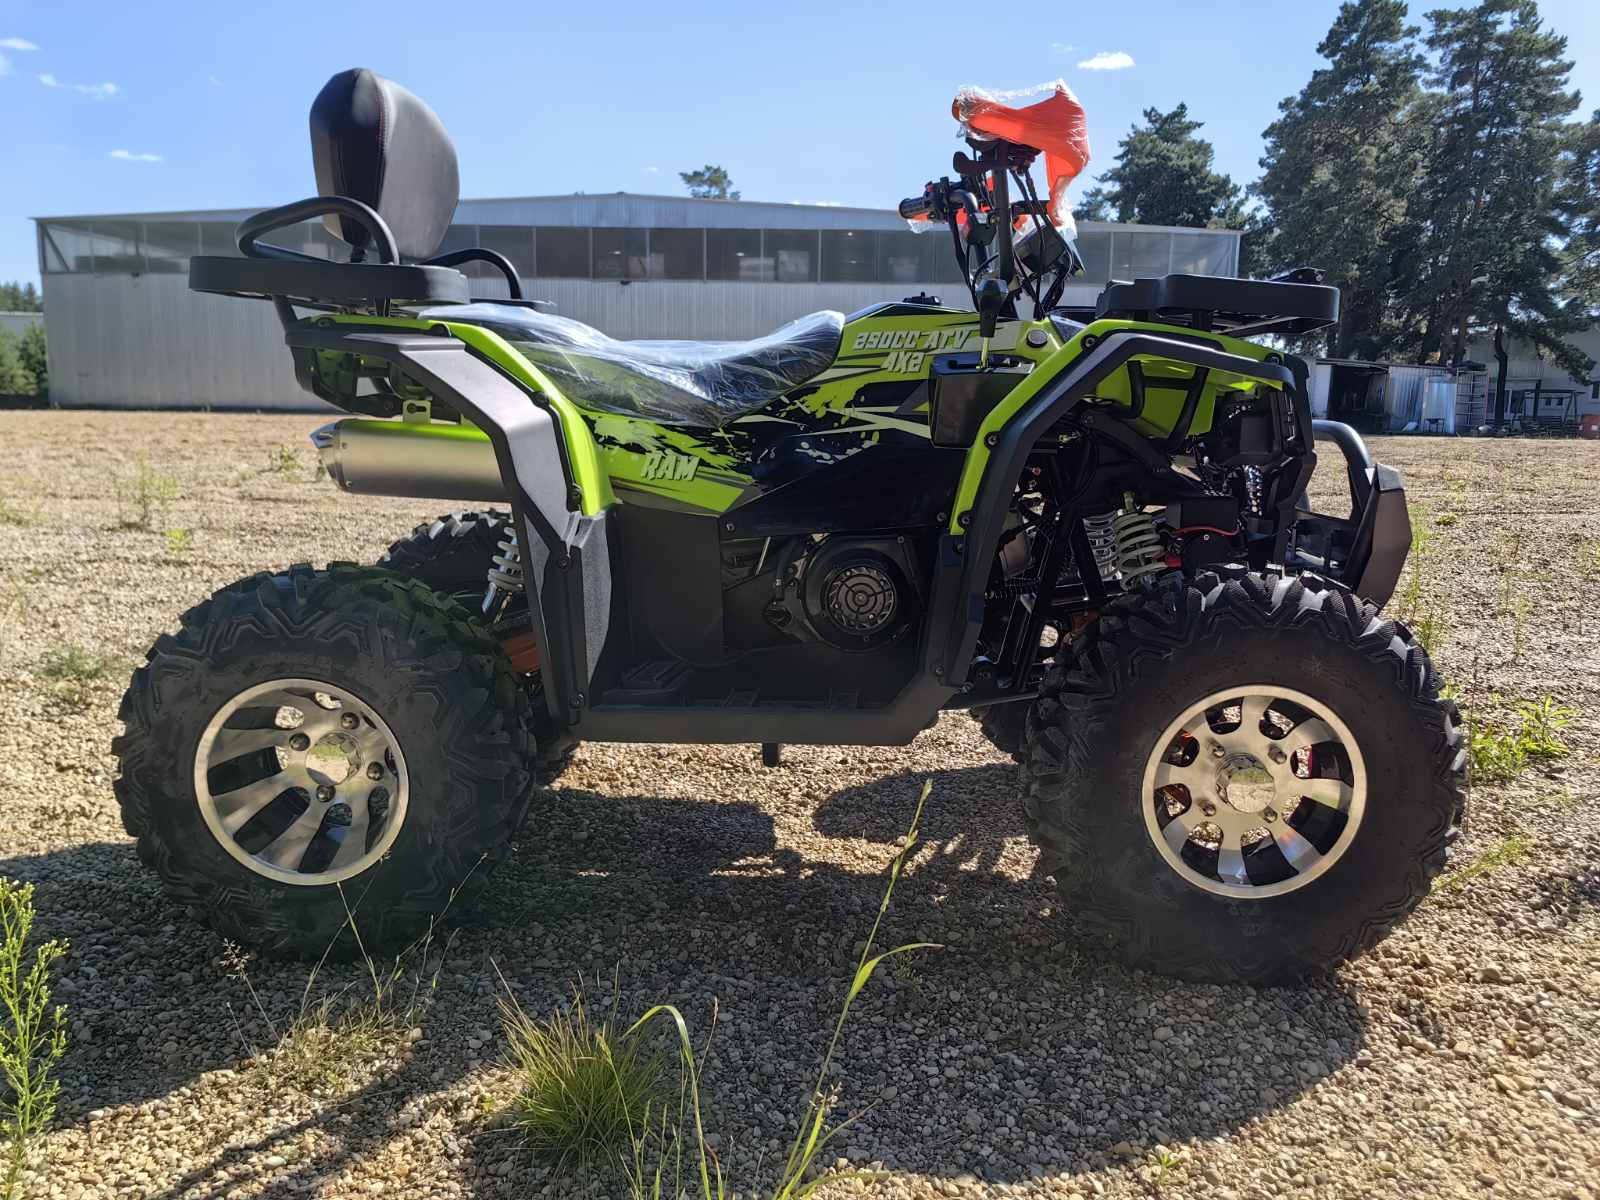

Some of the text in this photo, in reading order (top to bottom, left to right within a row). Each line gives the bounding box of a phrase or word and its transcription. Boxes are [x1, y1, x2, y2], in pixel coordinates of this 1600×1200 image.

[853, 329, 972, 350] 250CC ATV
[640, 451, 699, 481] RAM
